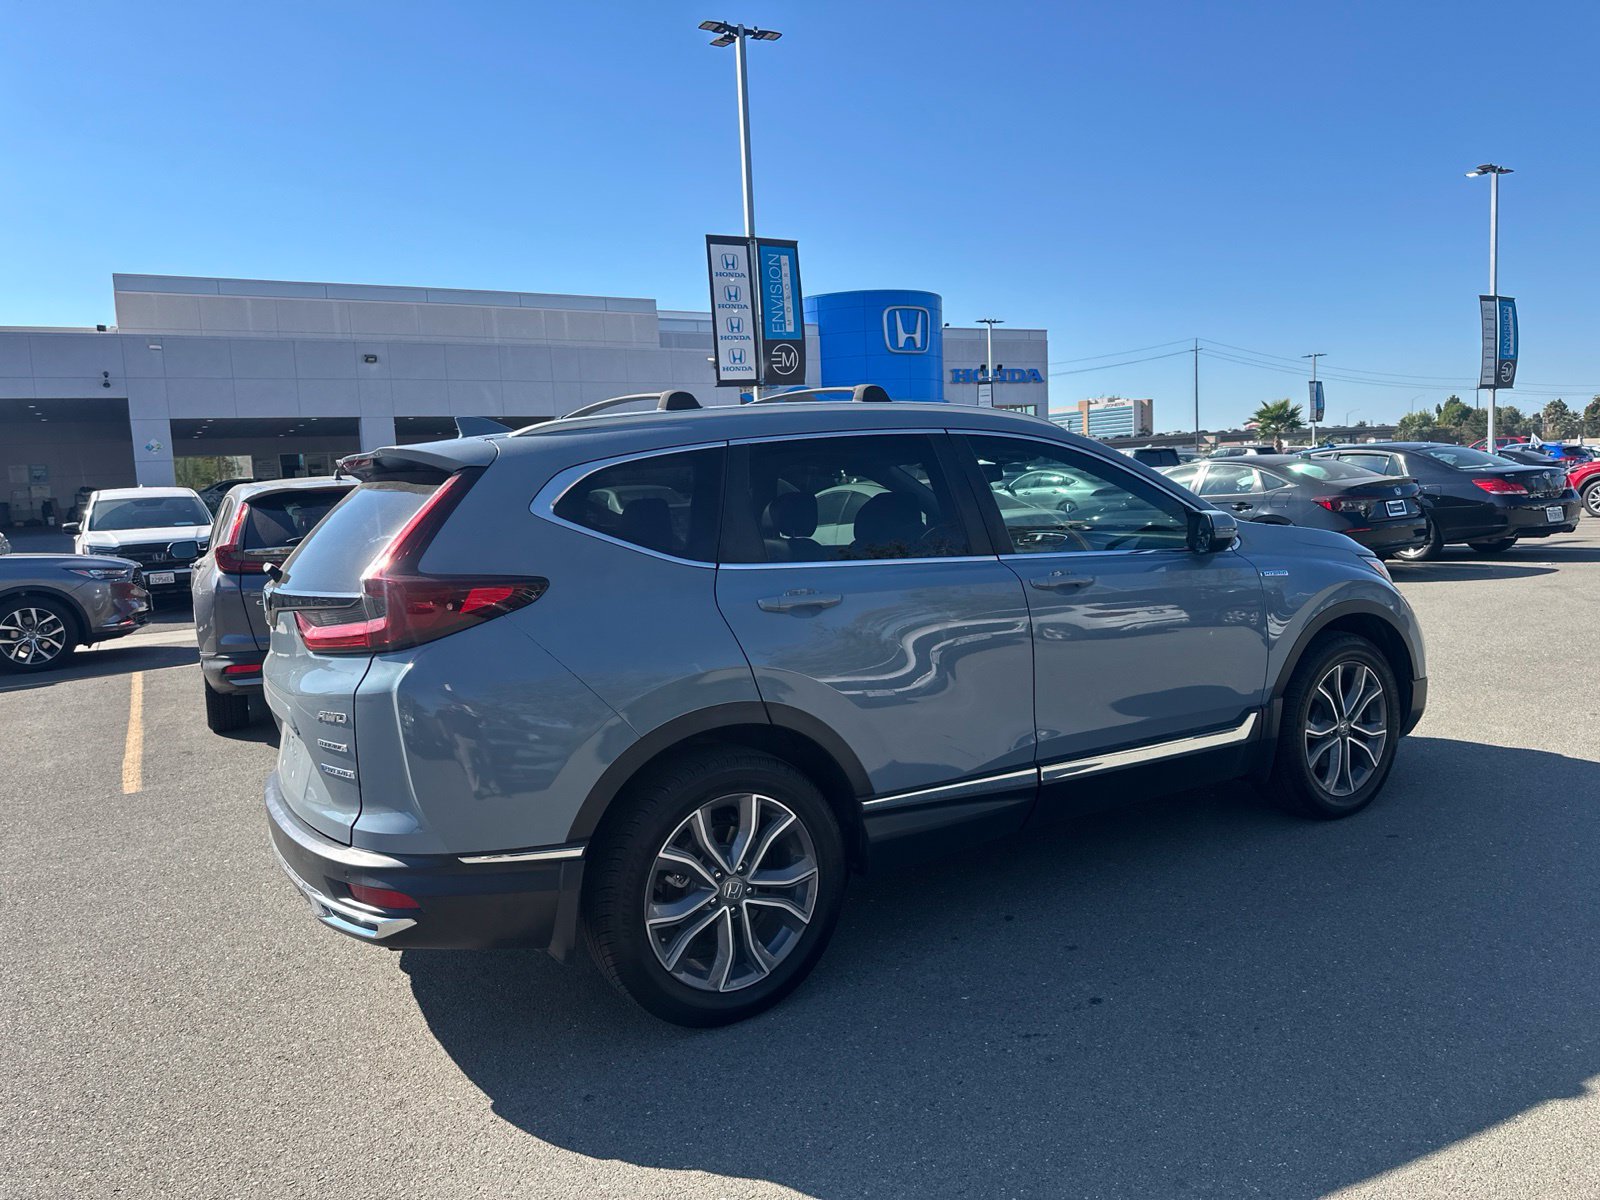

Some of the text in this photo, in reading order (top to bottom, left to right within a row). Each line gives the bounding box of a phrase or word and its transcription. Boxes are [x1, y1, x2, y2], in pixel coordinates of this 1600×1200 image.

[715, 271, 747, 279] HONDA
[768, 253, 786, 333] ENVISION
[950, 368, 1045, 384] HONDA
